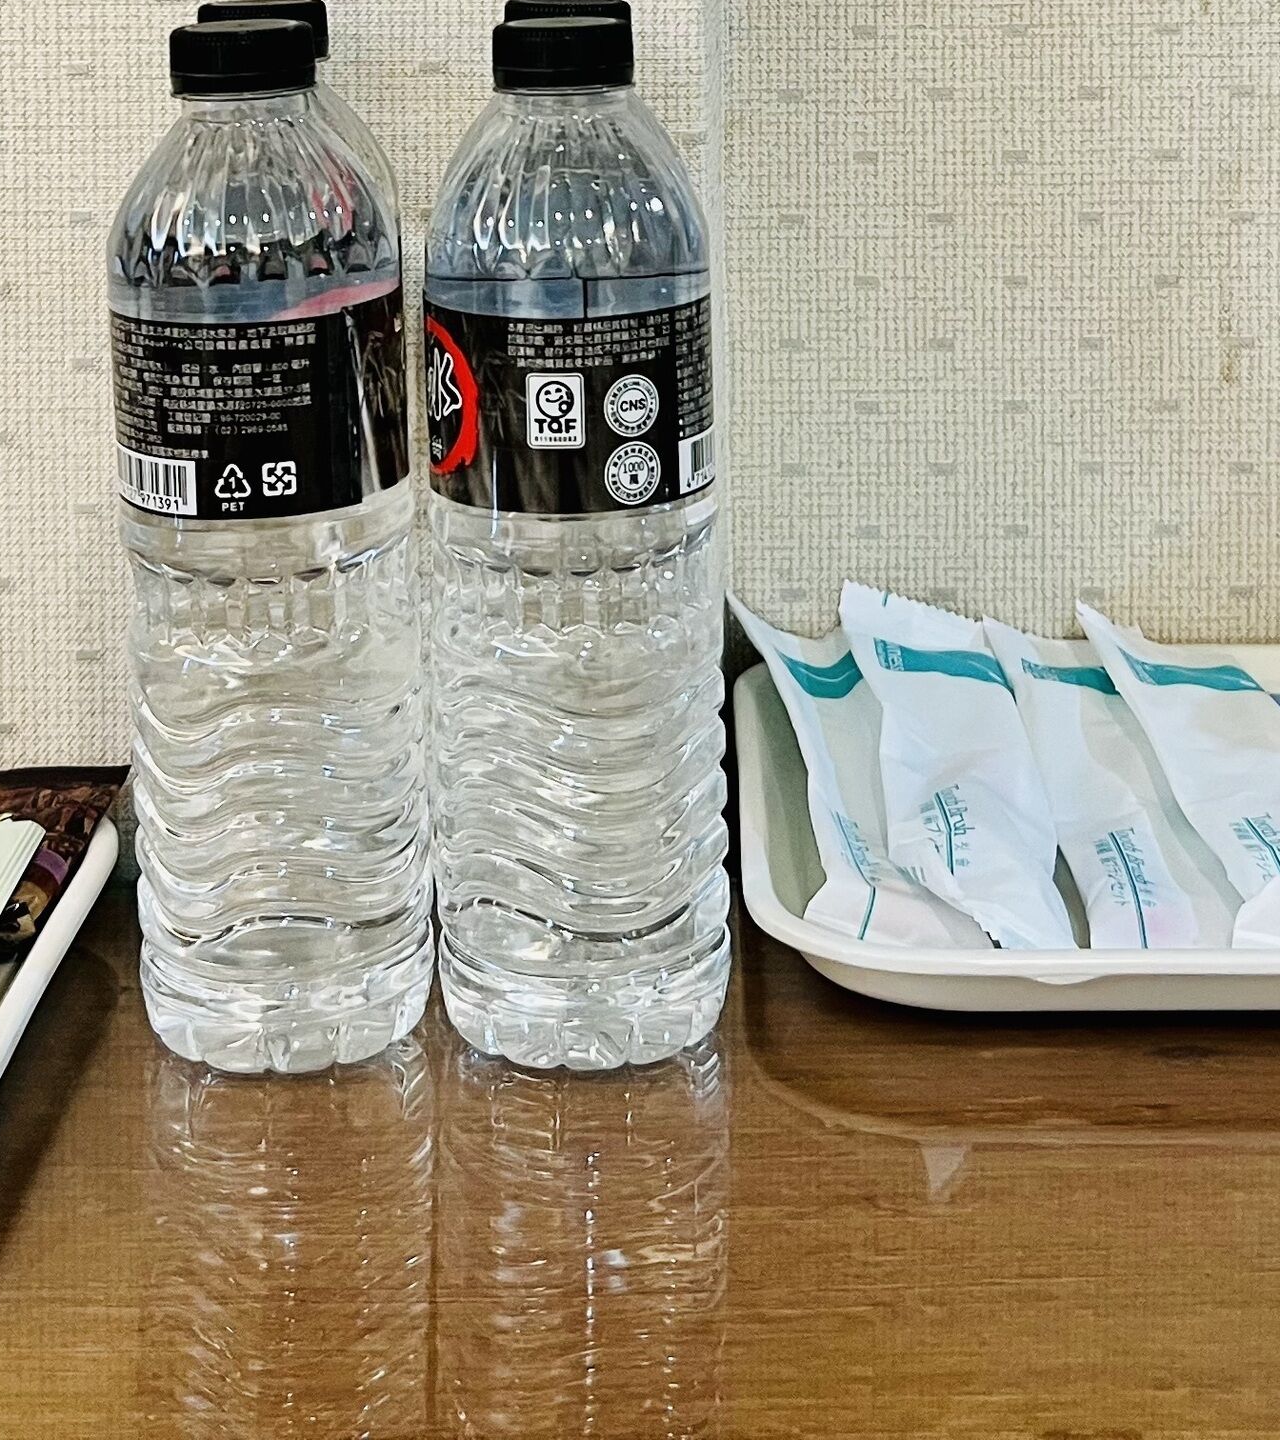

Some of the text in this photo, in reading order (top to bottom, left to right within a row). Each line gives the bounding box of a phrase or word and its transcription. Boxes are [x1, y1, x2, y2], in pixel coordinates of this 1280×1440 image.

[620, 398, 646, 412] CNS
[534, 418, 577, 434] TQF
[221, 502, 245, 512] PET
